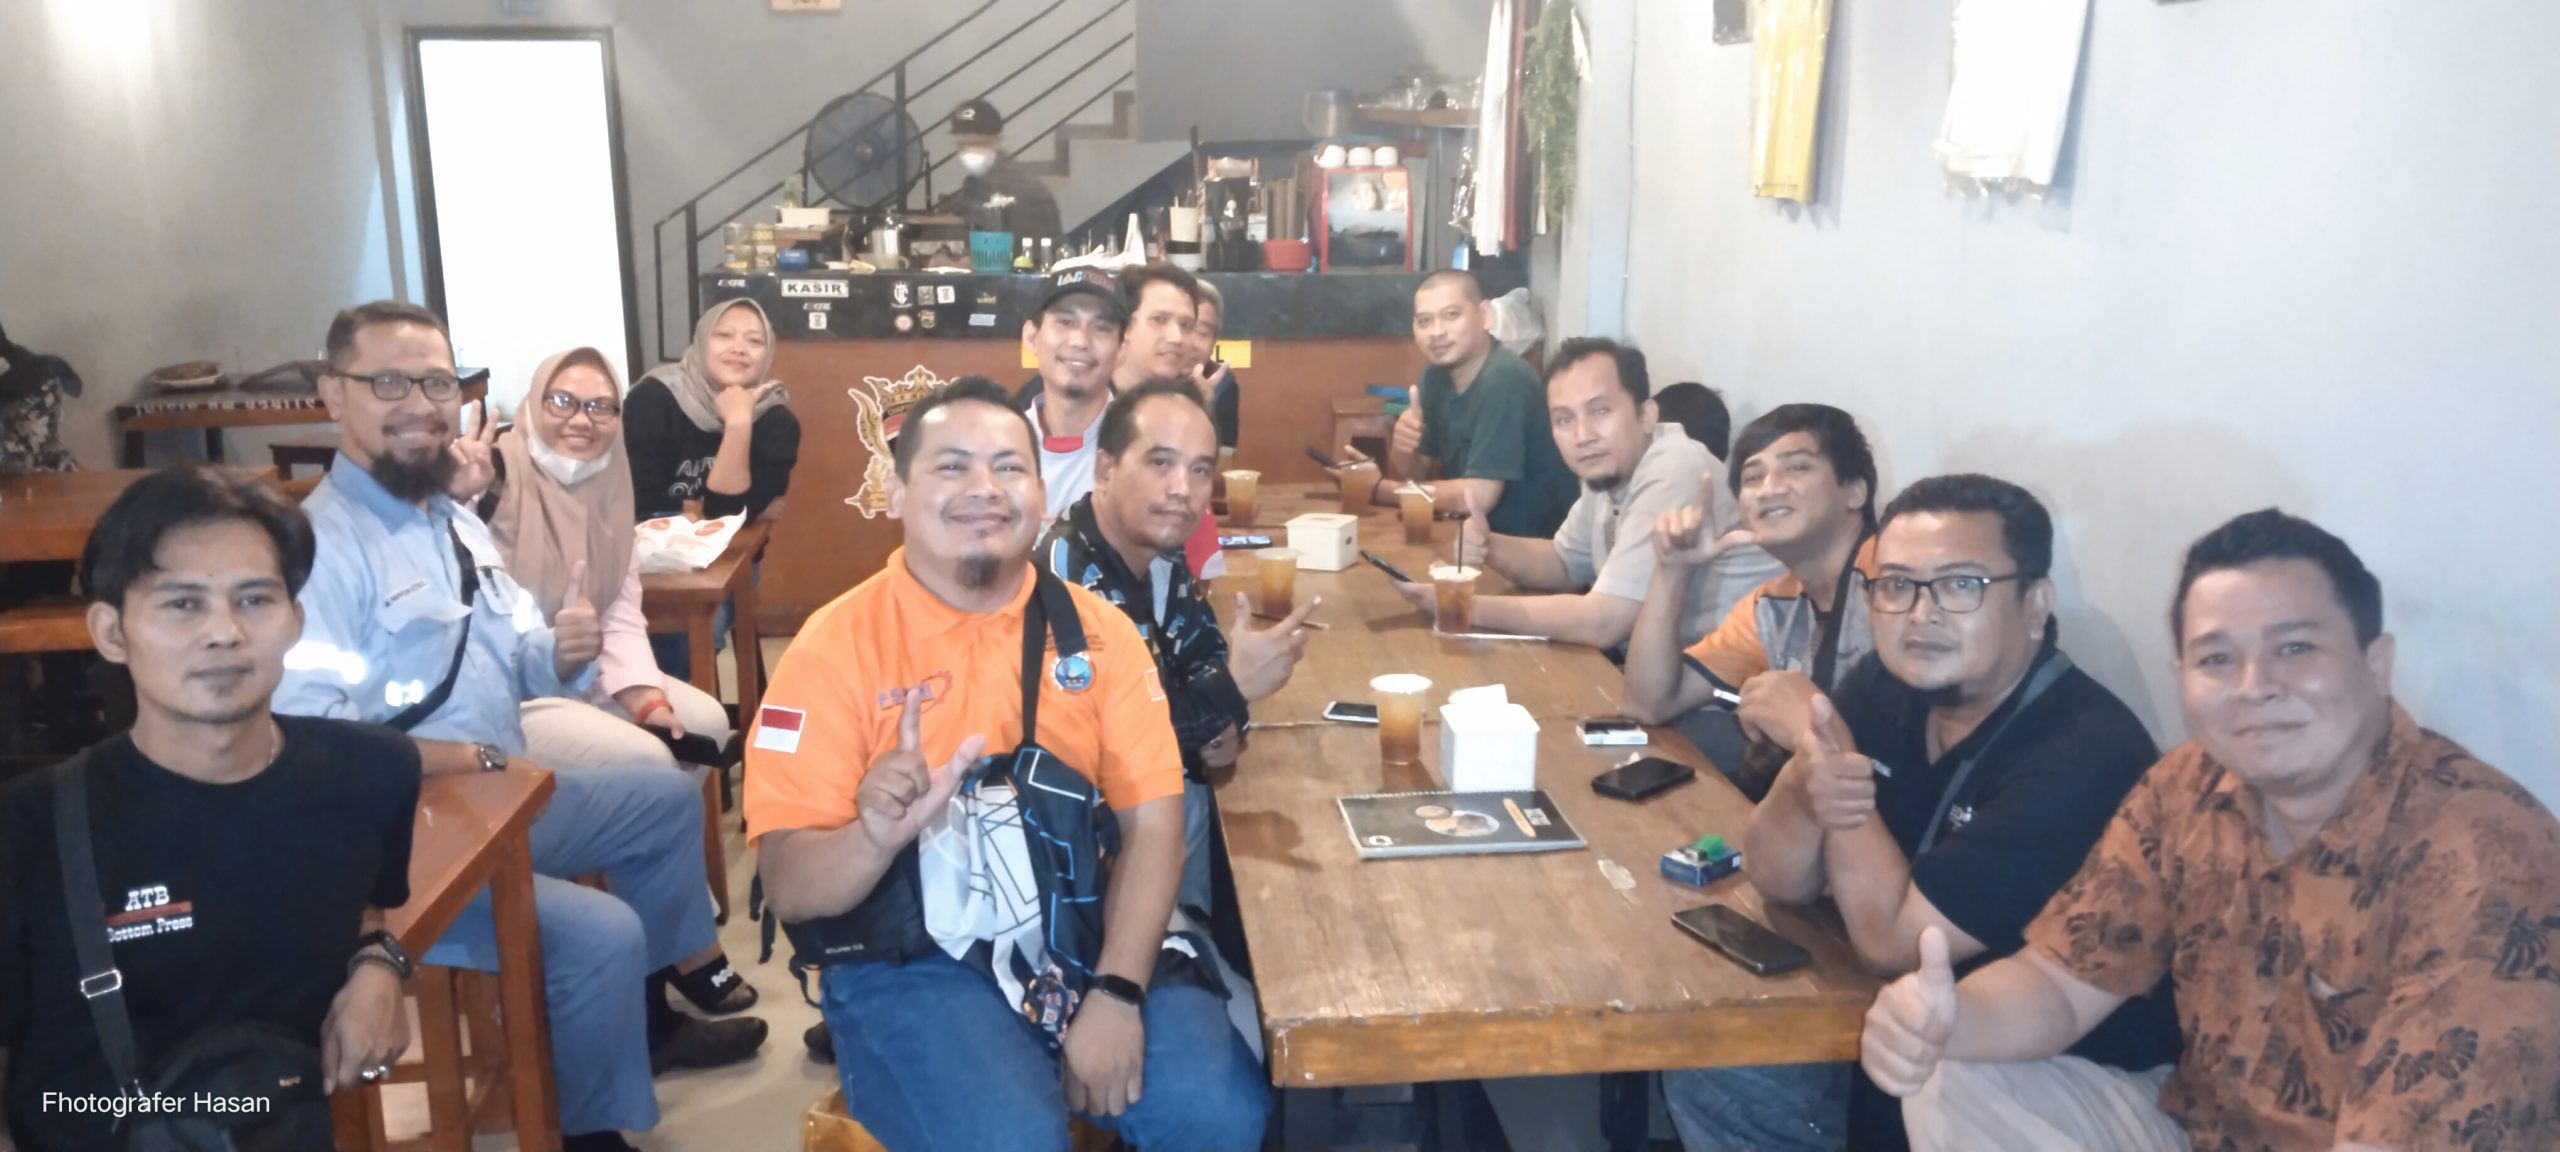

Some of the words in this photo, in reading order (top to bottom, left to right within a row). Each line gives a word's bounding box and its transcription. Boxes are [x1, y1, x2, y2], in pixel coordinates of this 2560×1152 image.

[787, 283, 842, 294] KASIR
[125, 886, 170, 911] ATB
[156, 916, 192, 933] Press
